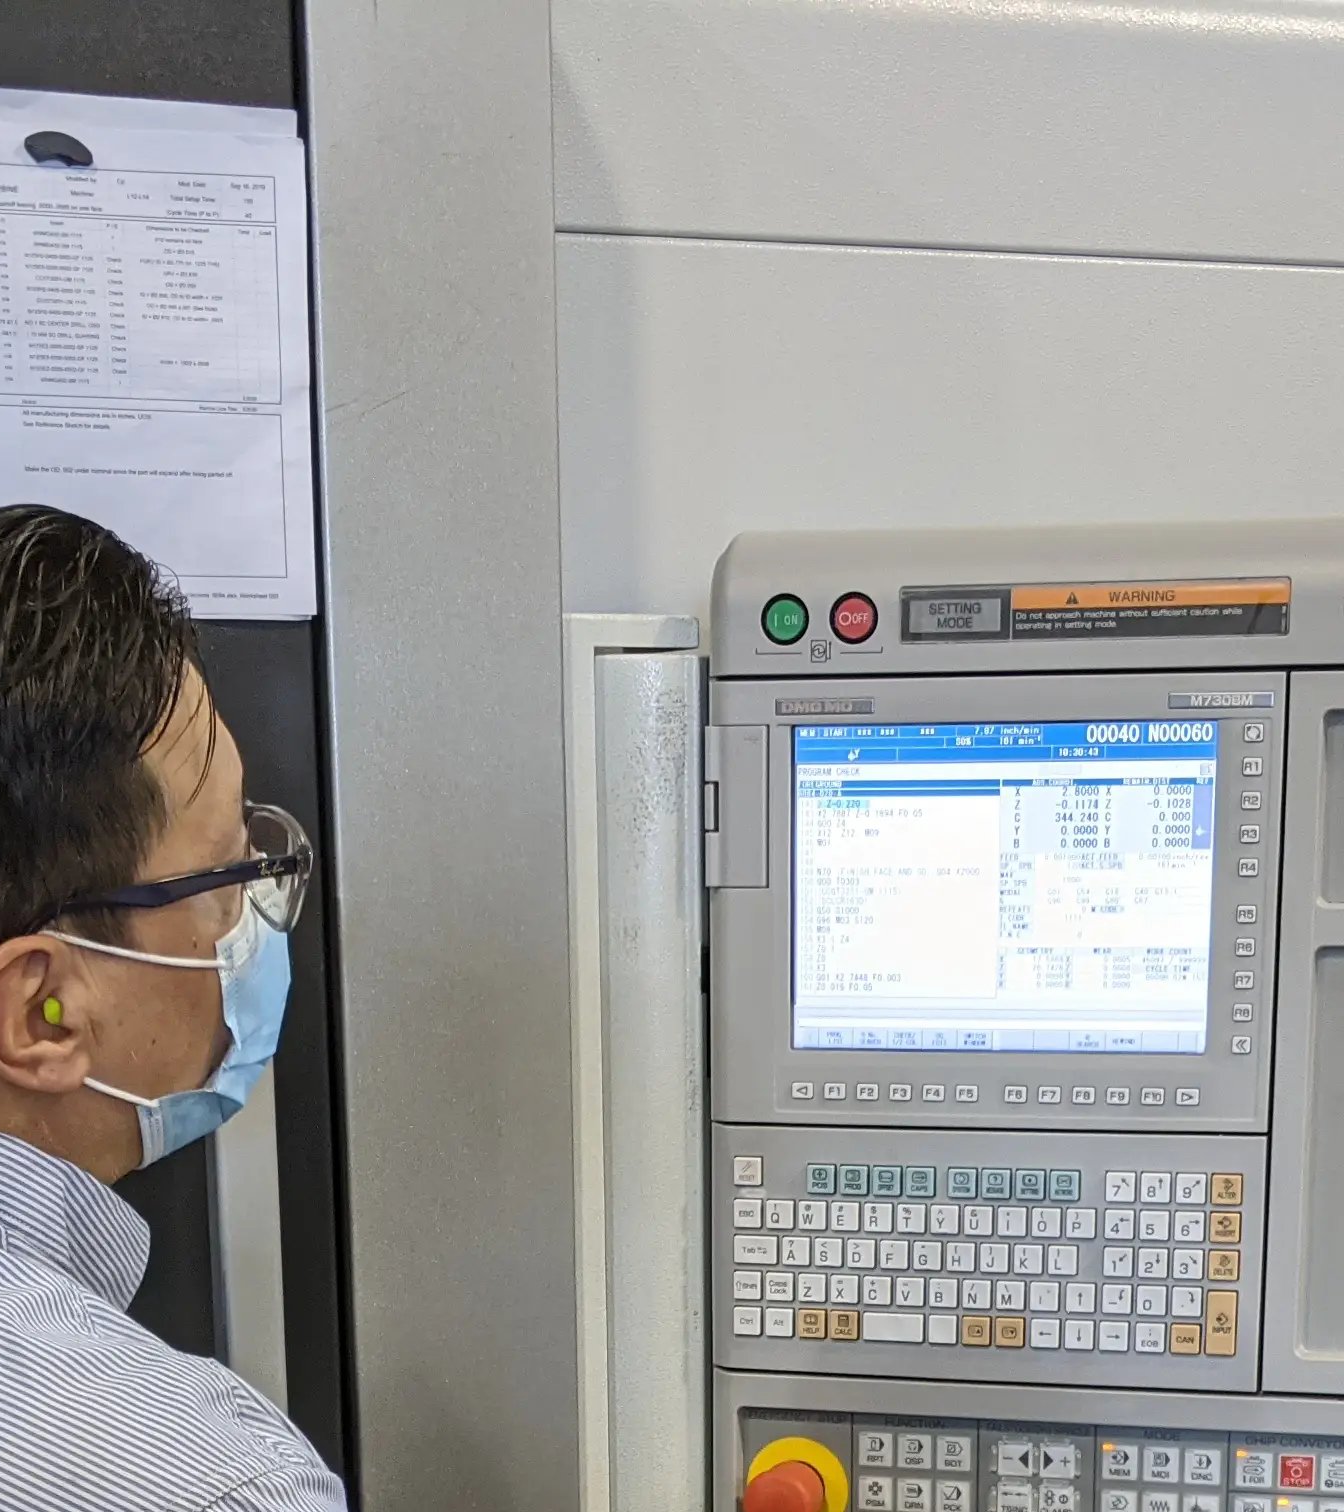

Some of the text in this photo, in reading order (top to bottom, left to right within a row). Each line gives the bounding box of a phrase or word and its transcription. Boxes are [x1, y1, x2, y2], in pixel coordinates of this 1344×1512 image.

[1109, 590, 1176, 602] WARNING
[929, 602, 981, 615] SETTING
[1016, 612, 1027, 620] Do
[1029, 612, 1043, 620] not
[1084, 610, 1116, 618] machine
[1190, 607, 1219, 616] caution
[1222, 607, 1242, 615] while
[784, 615, 797, 625] ON
[852, 614, 868, 624] OFF
[937, 616, 972, 629] MODE
[1148, 723, 1213, 742] N00060
[1244, 762, 1259, 771] R1
[798, 767, 860, 777] PROGRAM CHECK
[1015, 785, 1192, 797] X 2.8000 X 0.0000
[1014, 798, 1191, 810] Z -0.1174 Z -0.1028
[1243, 796, 1259, 805] R2
[1055, 812, 1191, 823] 344.240 C 0.000
[1014, 824, 1190, 836] Y 0.0000 Y 0.0000
[1243, 830, 1257, 839] R3
[1060, 838, 1190, 848] 0.0000 0.0000
[1241, 863, 1256, 872] R4
[1239, 910, 1254, 919] R5
[1237, 943, 1252, 952] R6
[1236, 976, 1251, 985] R7
[1235, 1009, 1250, 1018] R8
[828, 1087, 840, 1096] F1
[859, 1087, 874, 1097] F2
[892, 1088, 907, 1097] F3
[925, 1088, 941, 1098] F4
[959, 1088, 974, 1098] F5
[1007, 1090, 1022, 1100] F6
[1041, 1090, 1056, 1100] F7
[1075, 1091, 1090, 1101] F8
[1109, 1091, 1125, 1101] F9
[1144, 1091, 1162, 1102] F10
[770, 1287, 787, 1295] Lock
[803, 1327, 820, 1335] HELP
[1176, 1336, 1194, 1344] CAN
[1144, 1431, 1180, 1442] MODE
[1245, 1436, 1276, 1445] CHIP
[1108, 1468, 1130, 1477] MEM
[1151, 1470, 1170, 1479] MDI
[1190, 1471, 1213, 1481] DNC
